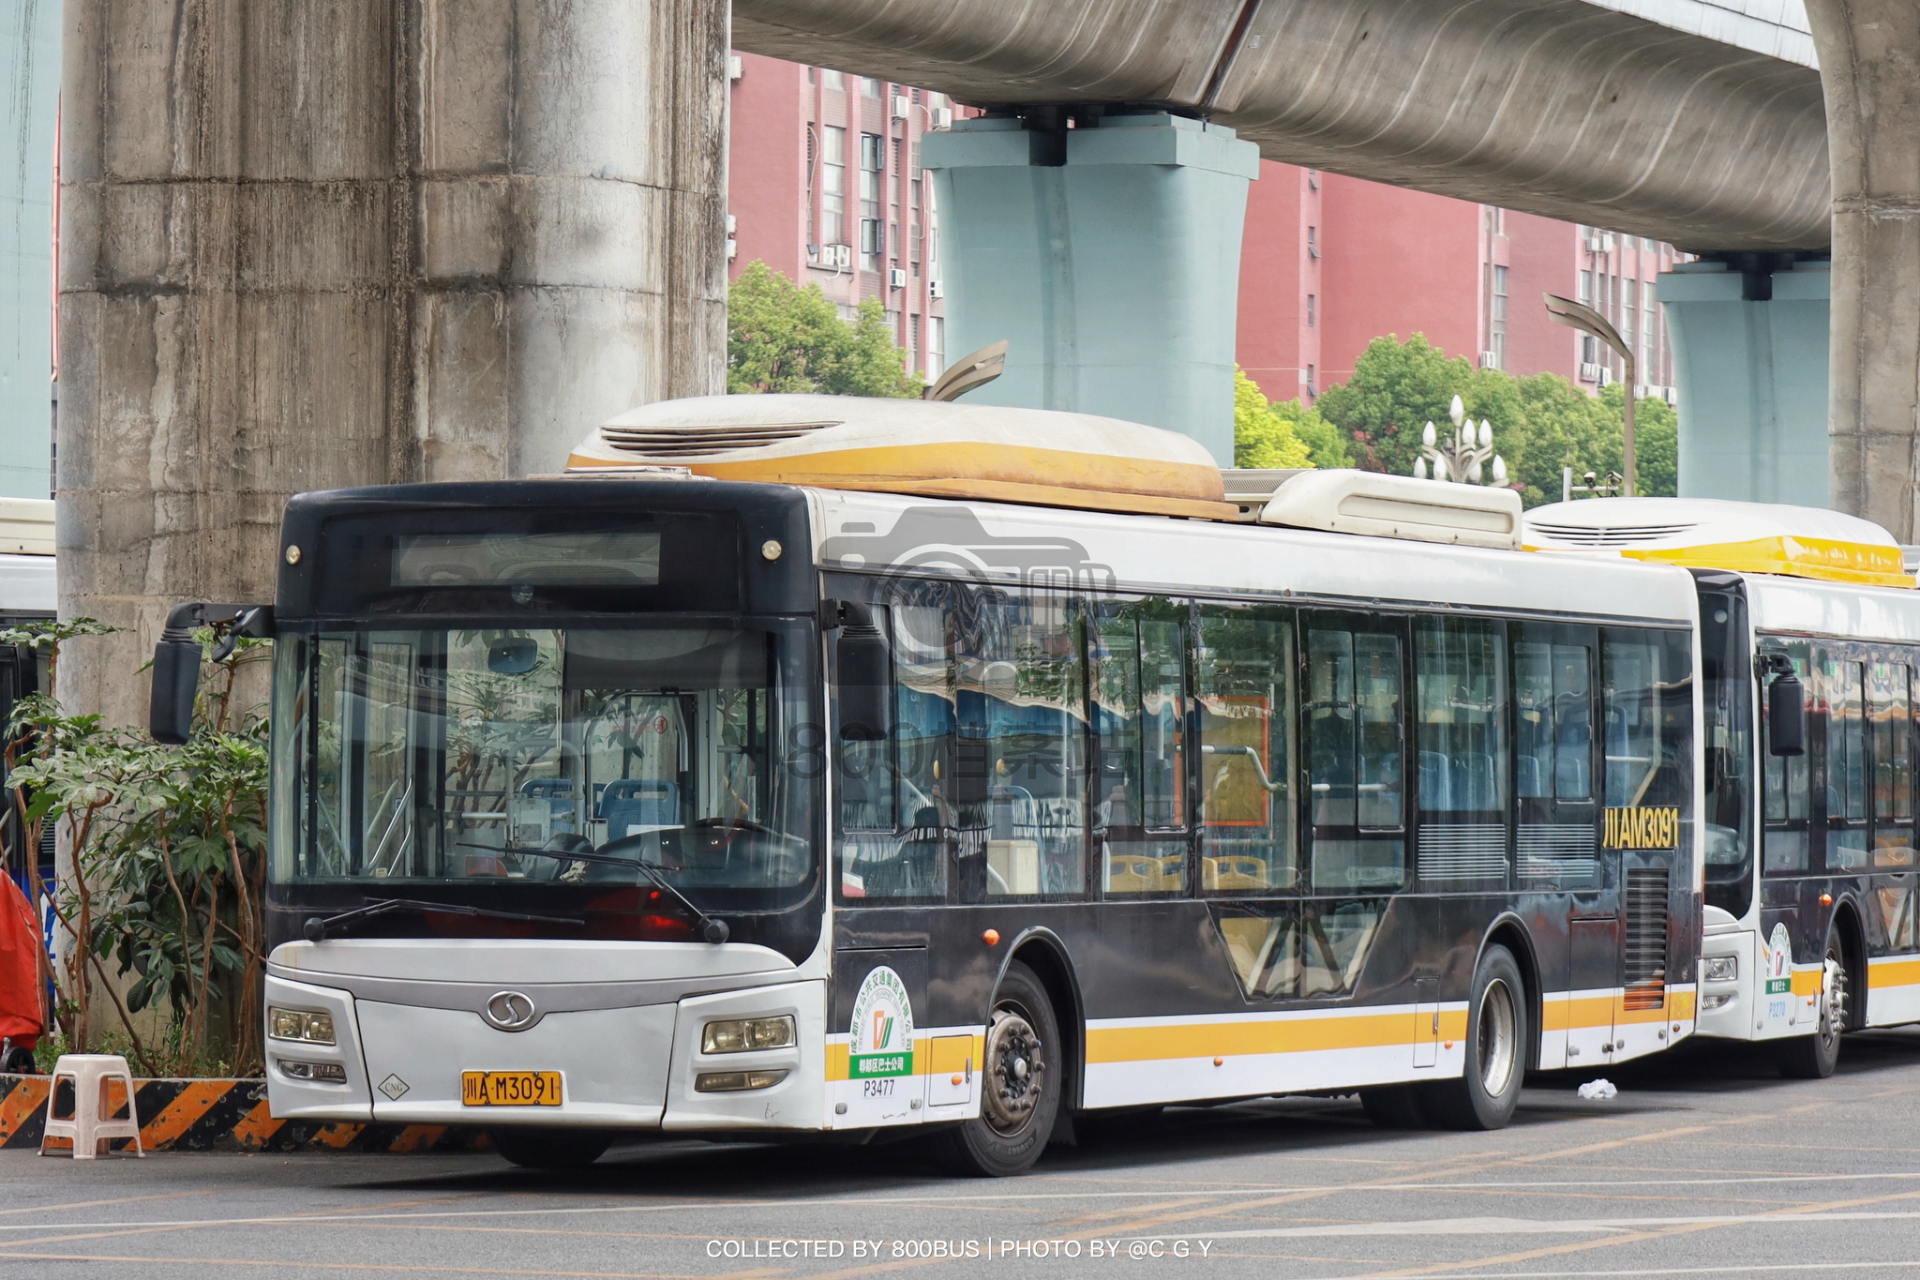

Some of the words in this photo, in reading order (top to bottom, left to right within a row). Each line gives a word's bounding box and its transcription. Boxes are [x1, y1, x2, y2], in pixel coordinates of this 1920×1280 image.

[1602, 806, 1678, 849] 川AM3091
[384, 1082, 403, 1093] CNG
[863, 1079, 895, 1097] P3477
